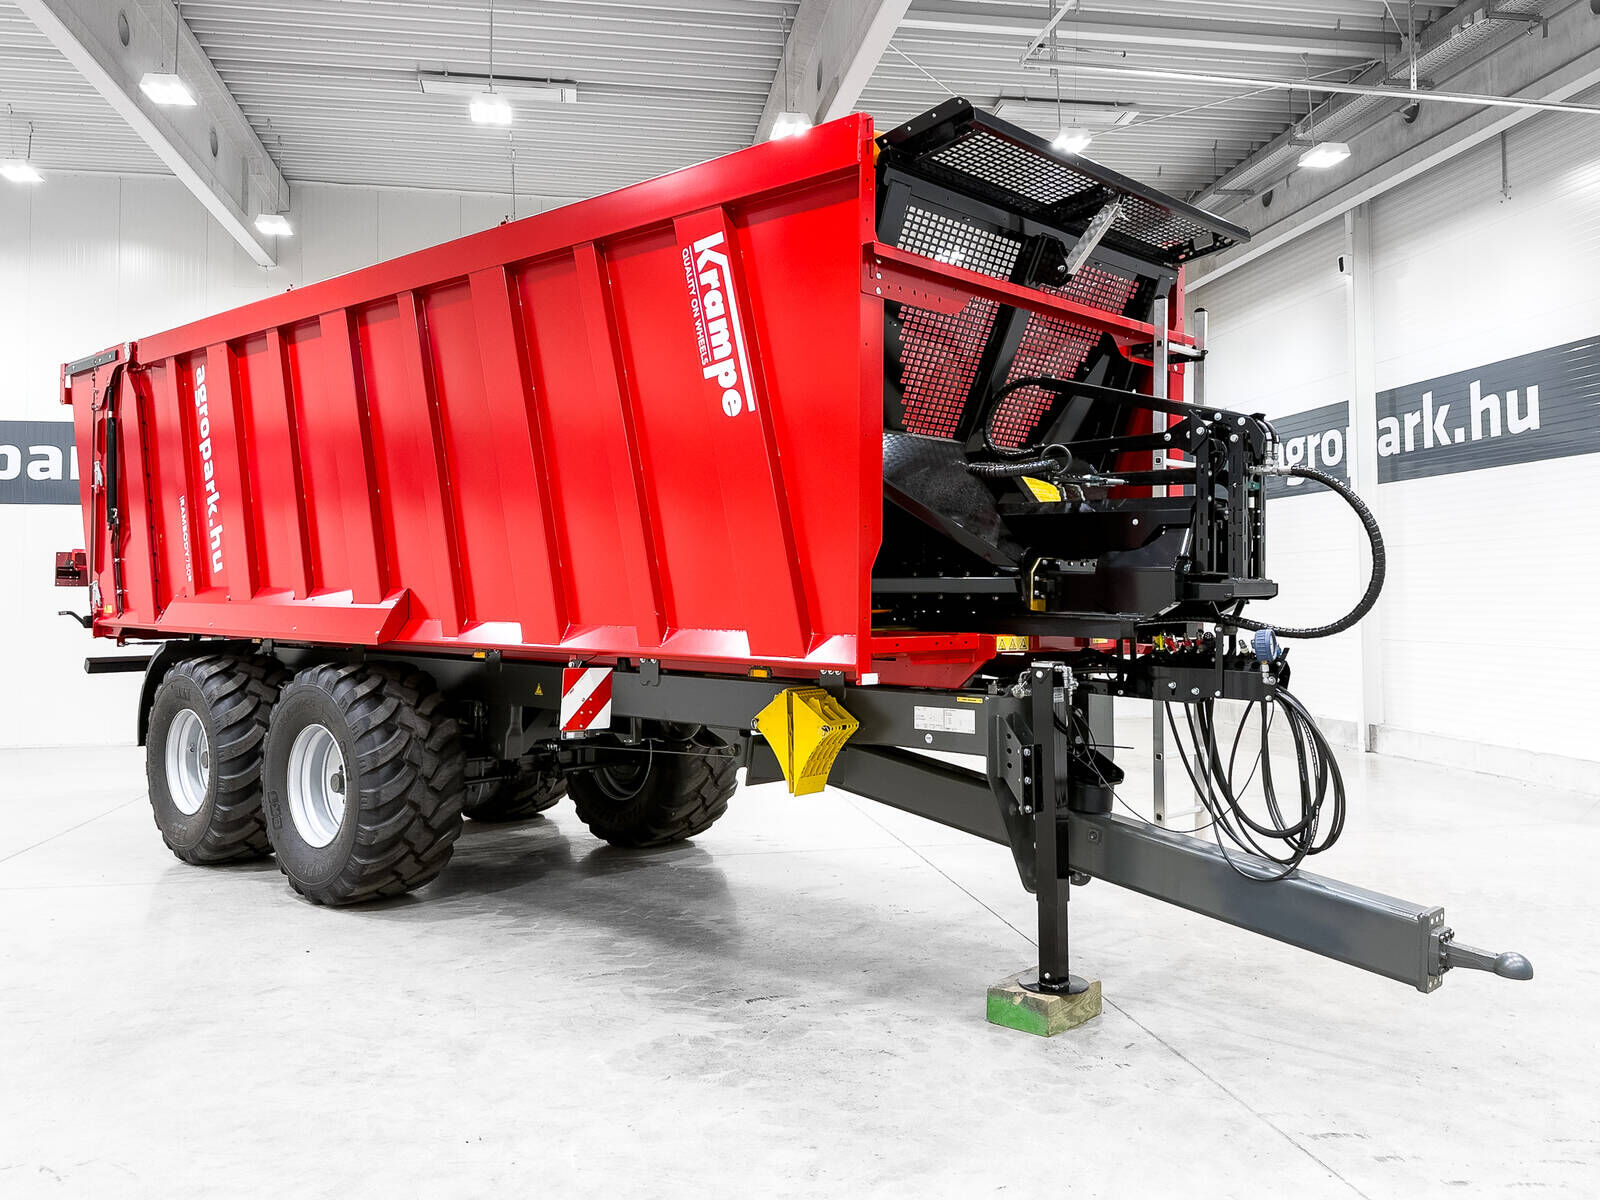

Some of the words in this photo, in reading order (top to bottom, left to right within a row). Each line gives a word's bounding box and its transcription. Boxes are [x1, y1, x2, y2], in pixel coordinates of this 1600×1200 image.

[681, 247, 696, 295] QUALITY
[690, 298, 701, 318] ON
[692, 231, 755, 417] Krampe
[695, 318, 709, 366] WHEELS
[193, 364, 223, 573] agropark.hu
